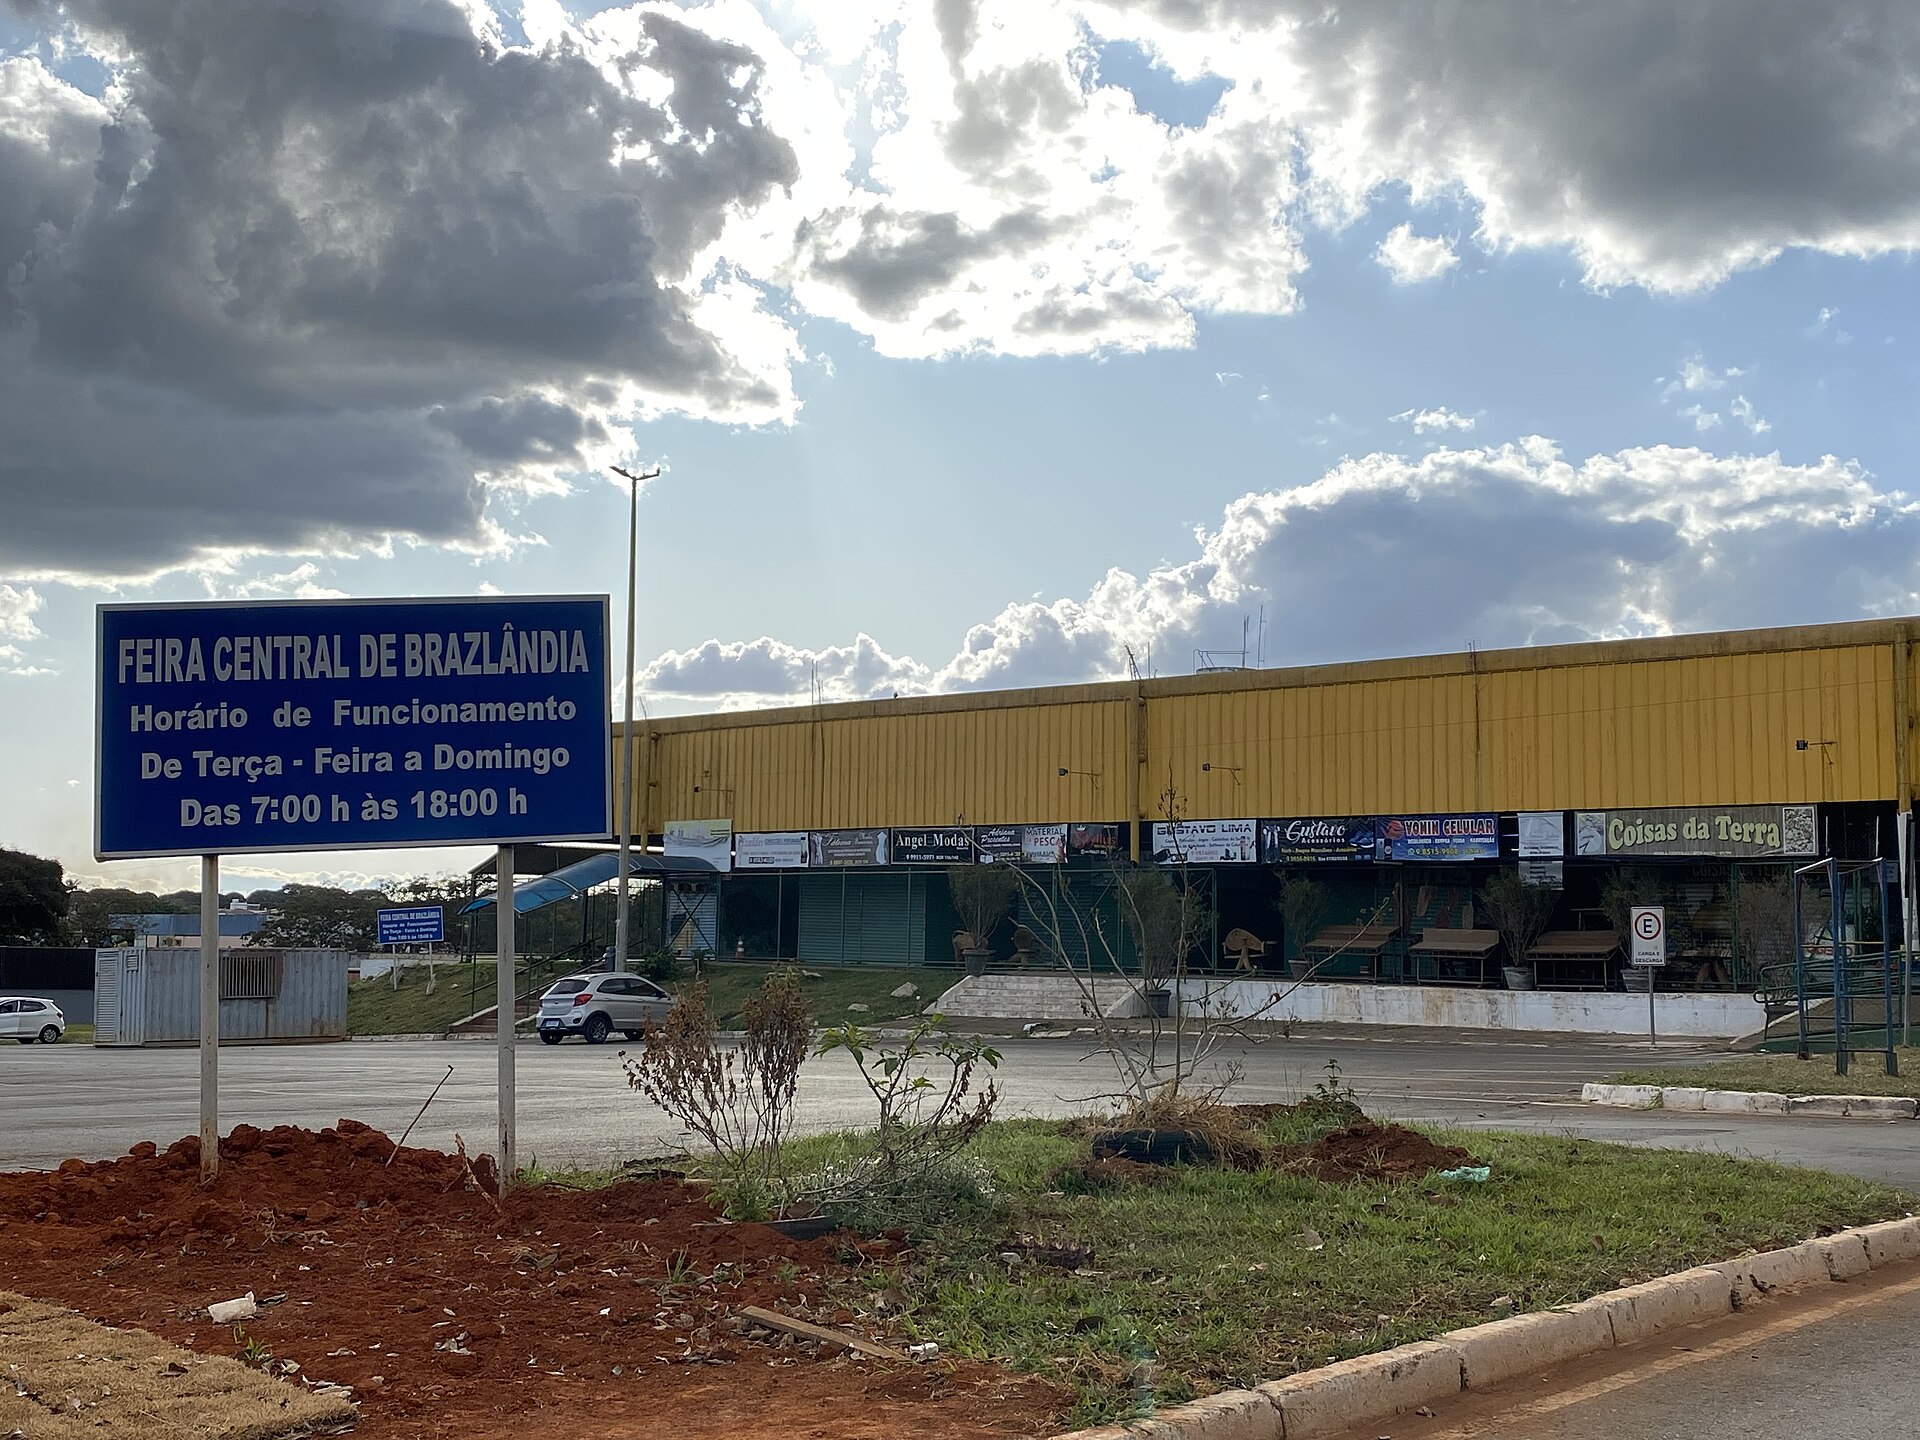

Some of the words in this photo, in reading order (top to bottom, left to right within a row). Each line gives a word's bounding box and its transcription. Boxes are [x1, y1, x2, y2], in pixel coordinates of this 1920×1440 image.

[118, 637, 206, 684] FEIRA
[213, 634, 350, 681] CENTRAL
[360, 632, 397, 678] DE
[404, 622, 589, 677] BRAZLÂNDIA
[130, 702, 248, 733] Horário
[273, 701, 311, 728] de
[333, 695, 577, 726] Funcionamento
[141, 752, 182, 780] De
[193, 750, 282, 783] Terça
[314, 746, 393, 774] Feira
[404, 751, 422, 772] a
[433, 743, 570, 775] Domingo
[180, 798, 241, 828] Das
[251, 795, 321, 825] 7:00
[331, 794, 349, 822] h
[361, 791, 398, 821] às
[410, 789, 499, 819] 18:00
[508, 787, 527, 815] h
[1026, 827, 1063, 836] MATERIAL
[1221, 823, 1252, 833] LIMA
[1284, 819, 1346, 844] Gustavo
[1443, 818, 1495, 836] CELULAR
[1608, 817, 1678, 850] Coisas
[1682, 816, 1710, 841] da
[1714, 815, 1781, 848] Terra
[895, 833, 927, 850] Angel
[933, 833, 970, 846] Modas
[1034, 836, 1062, 847] PESCA
[1643, 919, 1653, 933] E
